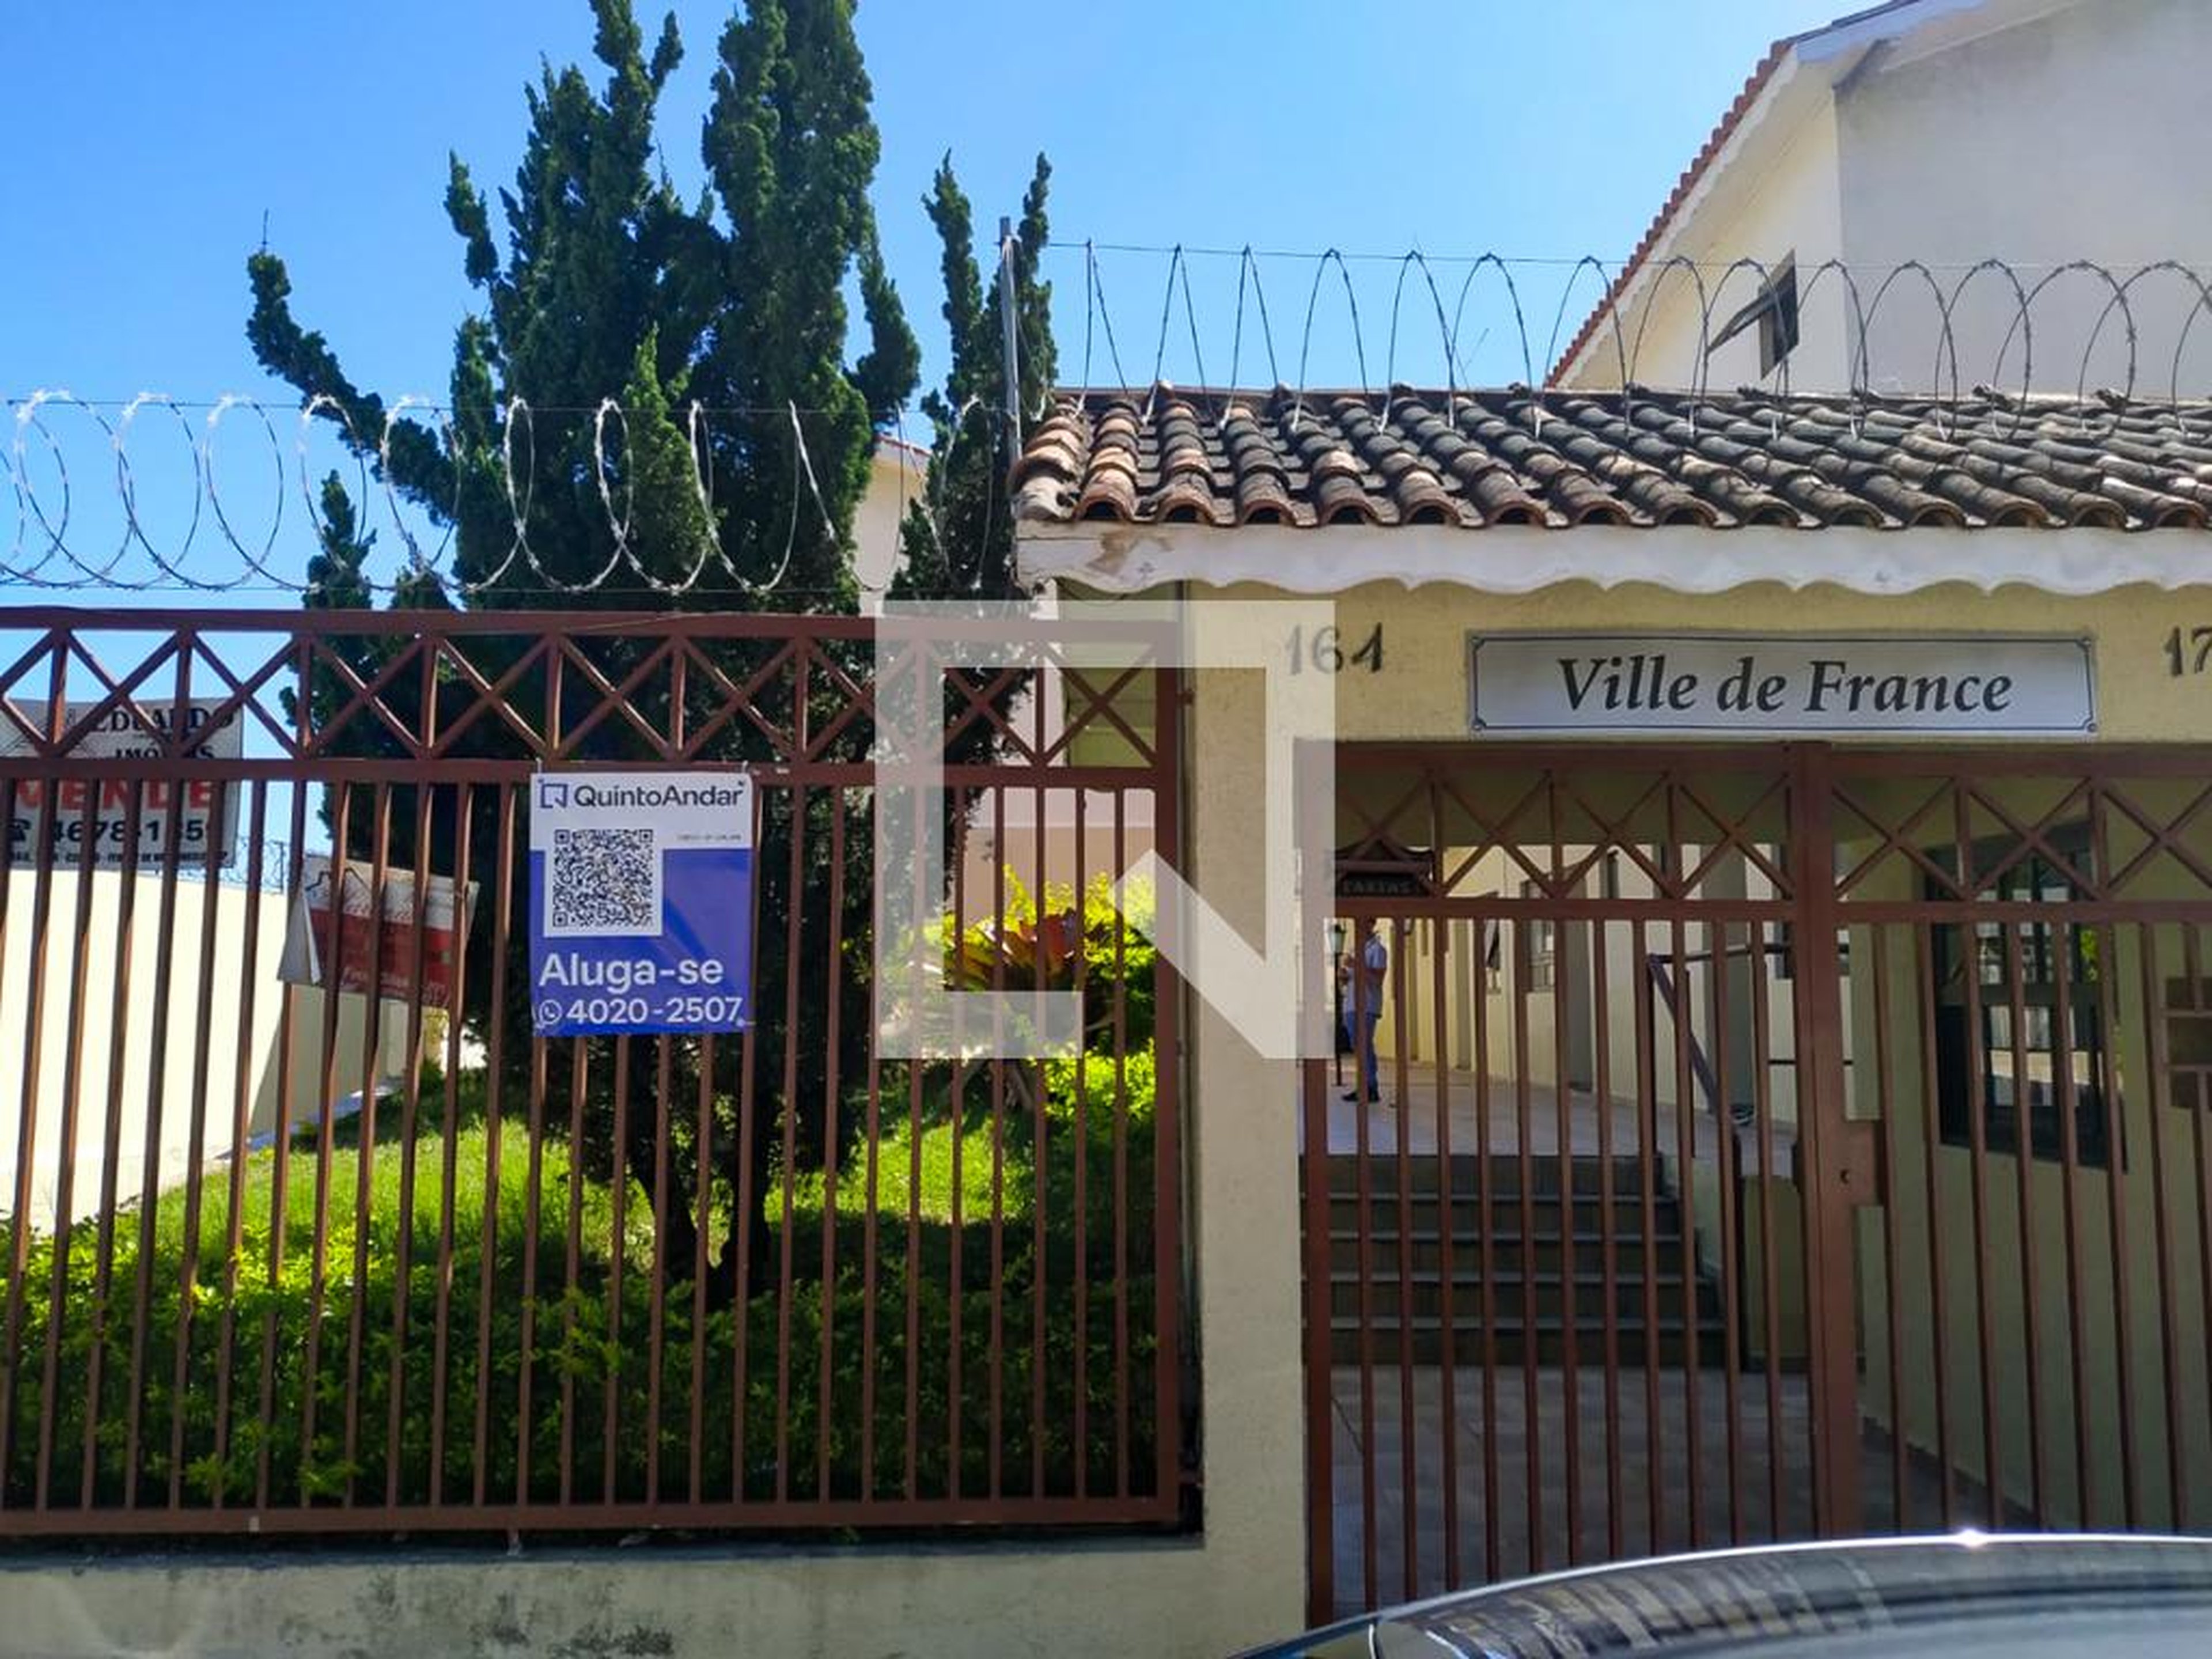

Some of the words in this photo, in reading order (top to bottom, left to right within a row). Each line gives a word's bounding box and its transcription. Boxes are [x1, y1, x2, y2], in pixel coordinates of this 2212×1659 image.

[1559, 654, 1698, 711] Ville
[1716, 656, 1786, 711] de
[1803, 660, 2013, 712] France
[574, 785, 743, 807] QuintoAndar
[539, 953, 724, 994] Aluga-se
[566, 997, 744, 1024] 4020-2507
